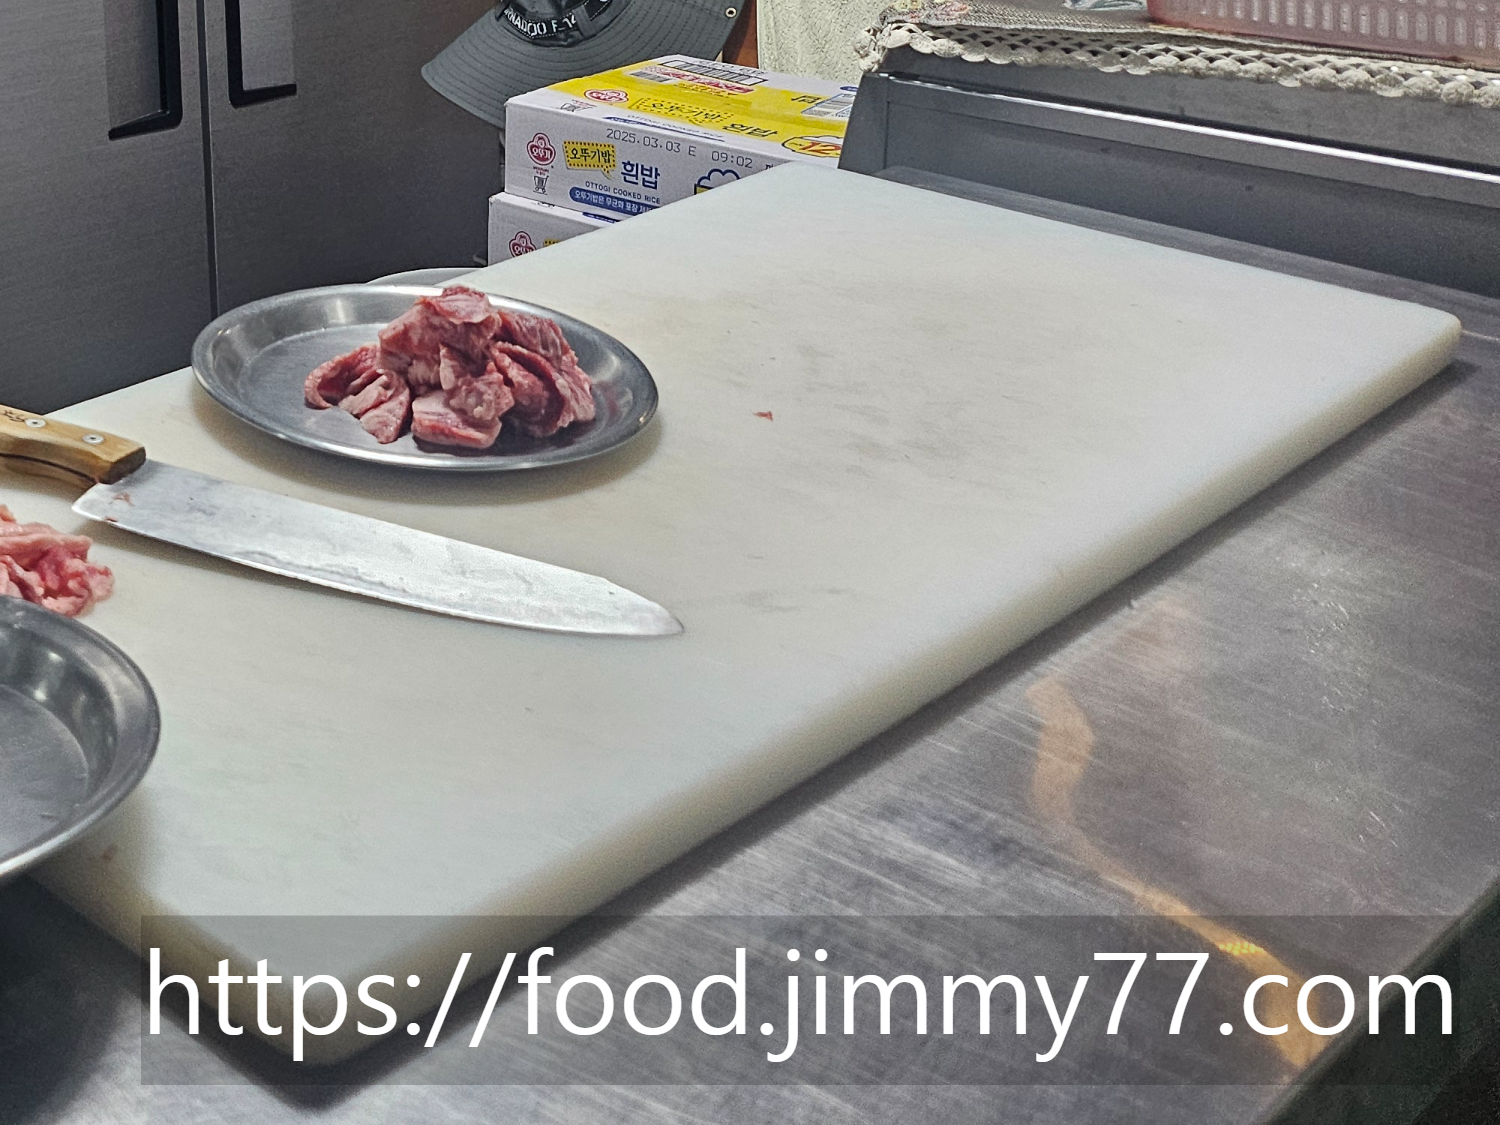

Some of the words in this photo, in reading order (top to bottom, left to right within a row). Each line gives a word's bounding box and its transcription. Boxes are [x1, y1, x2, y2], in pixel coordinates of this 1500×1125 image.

[650, 102, 723, 121] 오뚜기밥
[722, 123, 779, 138] 흰밥
[531, 148, 552, 160] 오뚜기
[569, 147, 612, 164] 오뚜기밥
[606, 127, 681, 154] 2025.03.03
[688, 145, 697, 157] E
[711, 150, 753, 169] 09:02
[620, 160, 661, 190] 흰밥
[574, 190, 605, 205] 오뚜기밥은
[625, 201, 639, 213] 포장
[585, 180, 611, 192] OTTOGI
[612, 187, 642, 200] COOKED
[644, 194, 661, 205] RICE
